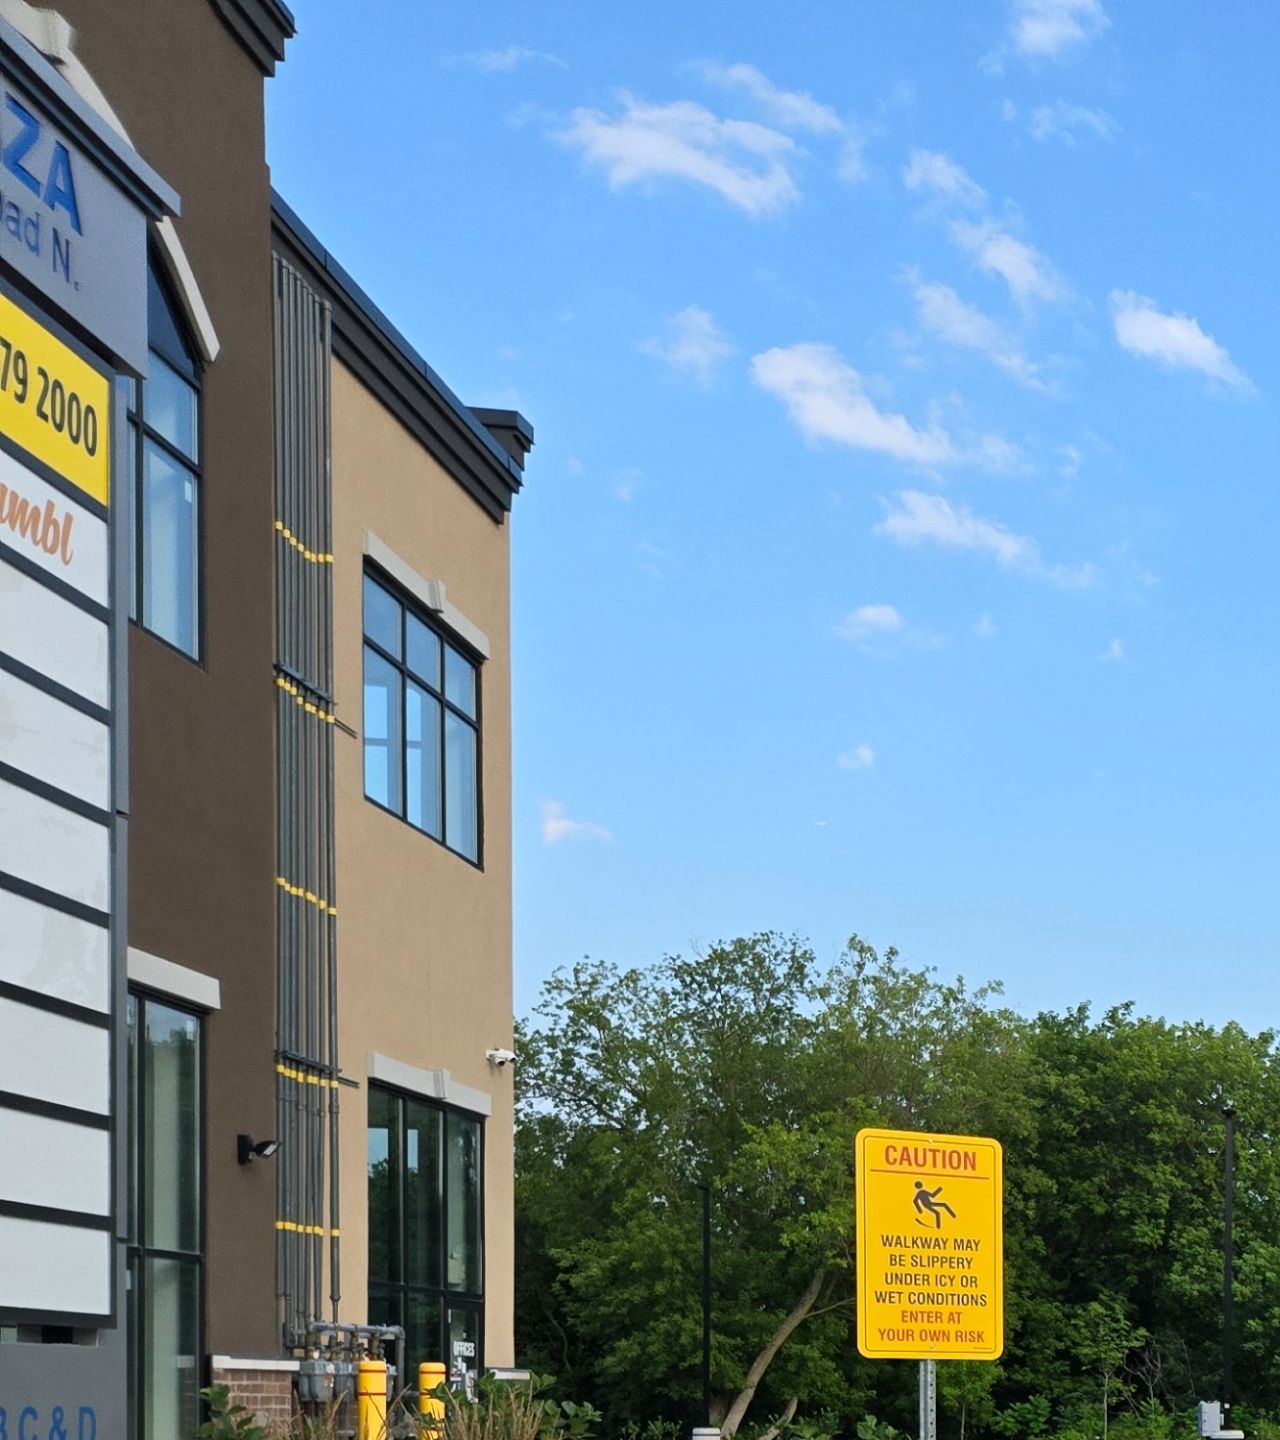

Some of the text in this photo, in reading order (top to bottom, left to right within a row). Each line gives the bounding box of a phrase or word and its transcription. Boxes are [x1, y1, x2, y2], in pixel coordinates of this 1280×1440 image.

[0, 193, 40, 257] ad
[36, 366, 98, 457] 2000
[885, 1145, 976, 1171] CAUTION
[881, 1235, 981, 1252] WALKWAY MAY
[889, 1254, 974, 1269] BE SLIPPERY
[885, 1272, 978, 1288] UNDER ICY OR
[874, 1291, 987, 1307] WET CONDITIONS
[901, 1310, 963, 1324] ENTER AT
[878, 1328, 985, 1343] YOUR OWN RISK
